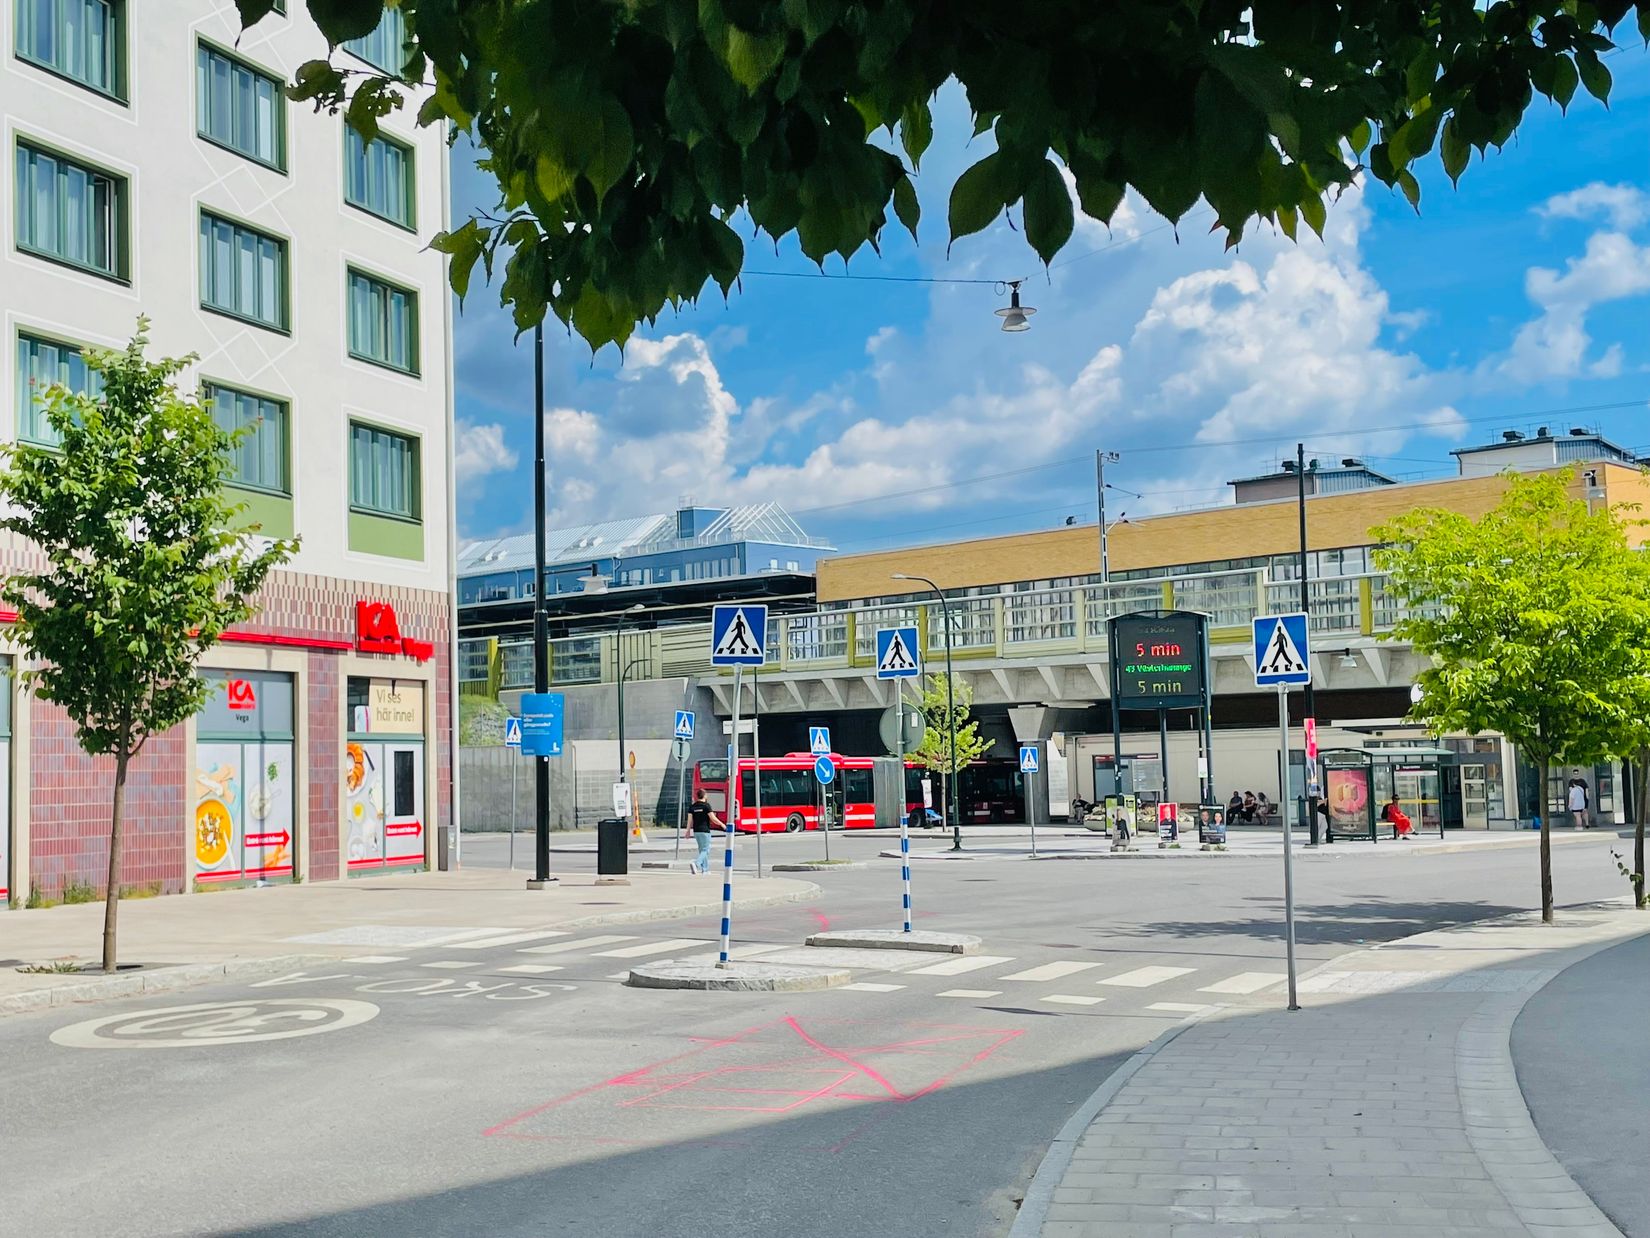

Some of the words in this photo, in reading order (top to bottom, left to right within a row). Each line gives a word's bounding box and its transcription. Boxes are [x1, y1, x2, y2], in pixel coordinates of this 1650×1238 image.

[1136, 643, 1145, 657] 5
[1151, 642, 1181, 656] min
[228, 680, 256, 701] ICA
[1138, 680, 1146, 694] 5
[1152, 680, 1182, 693] min
[376, 689, 386, 703] Vi
[387, 693, 402, 704] ses
[376, 707, 392, 721] här
[248, 971, 578, 1000] SKOA
